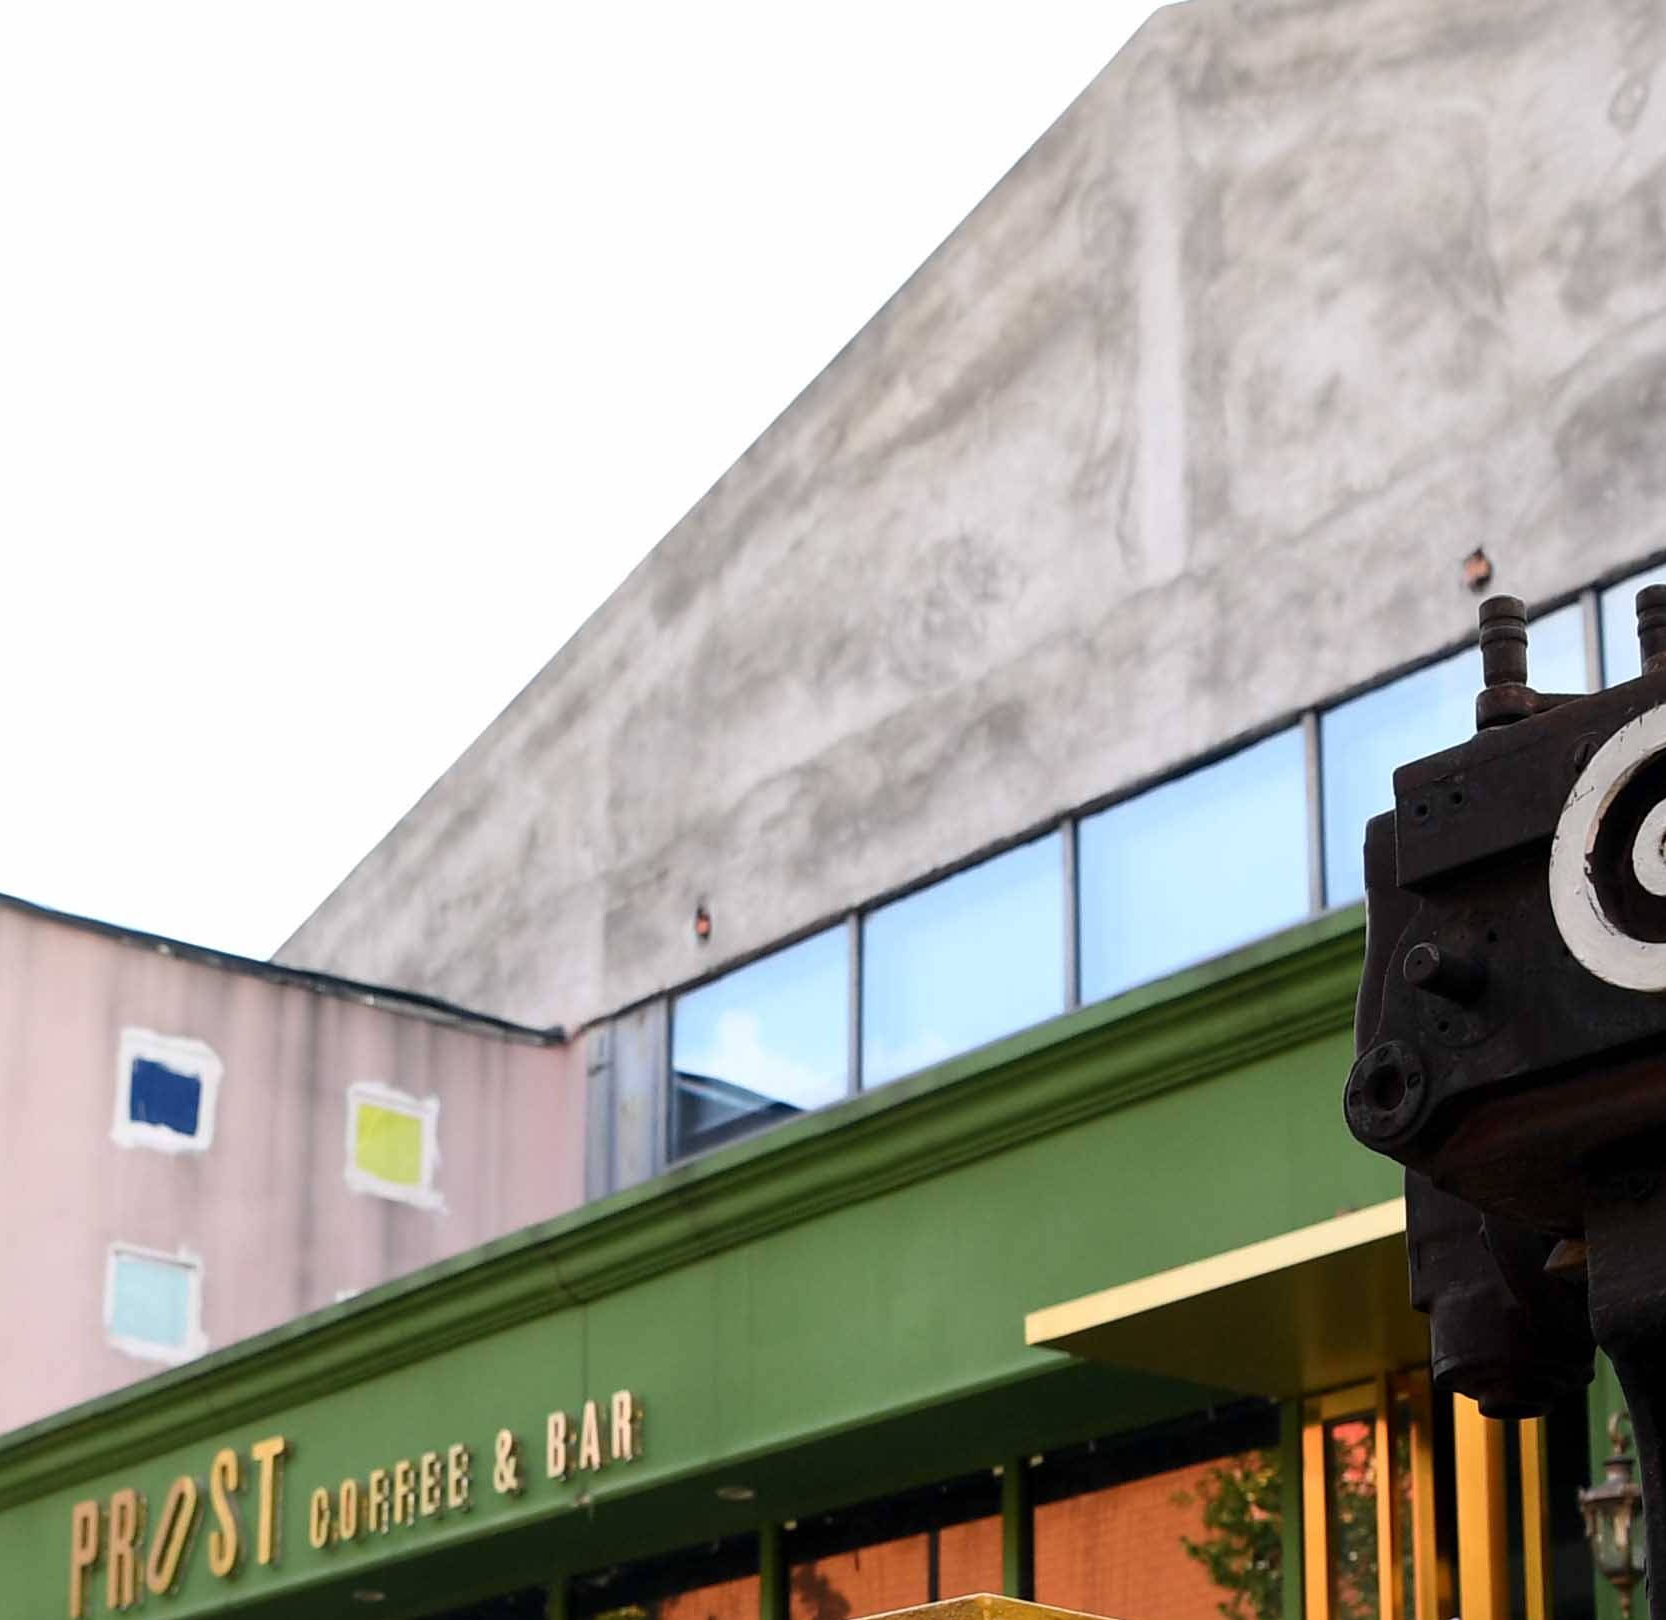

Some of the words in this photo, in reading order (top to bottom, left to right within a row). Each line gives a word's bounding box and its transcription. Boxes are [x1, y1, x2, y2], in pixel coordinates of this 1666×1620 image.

[69, 1435, 287, 1620] PROST
[309, 1442, 468, 1549] COFFEE
[493, 1429, 521, 1494] &
[546, 1389, 640, 1480] BAR
